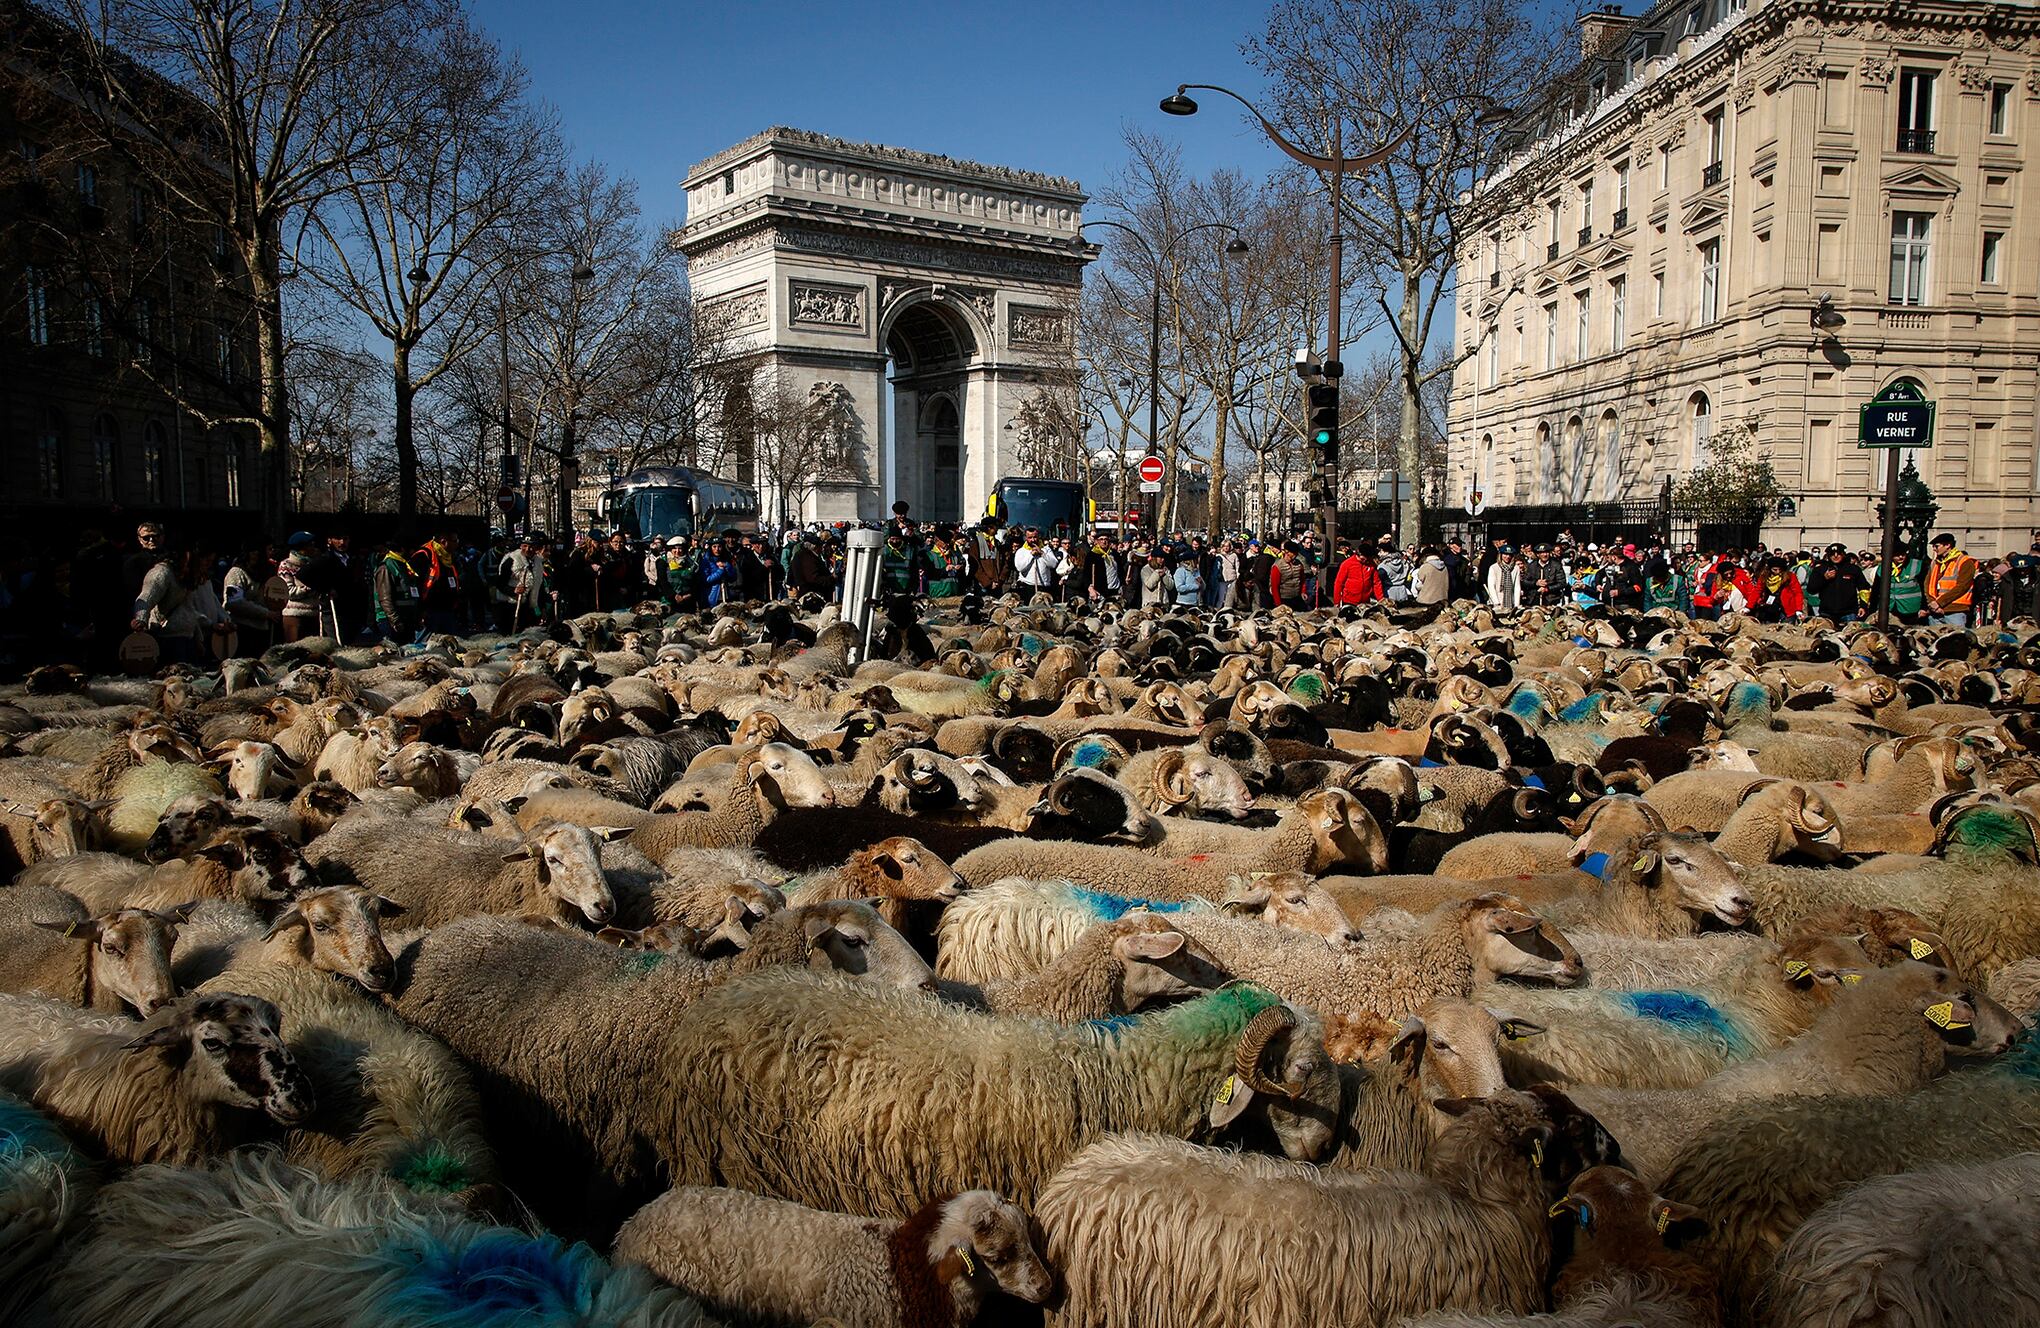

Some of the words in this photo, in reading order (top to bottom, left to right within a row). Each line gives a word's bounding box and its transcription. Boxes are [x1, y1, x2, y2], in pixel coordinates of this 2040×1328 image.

[1887, 412, 1908, 422] RUE
[1876, 427, 1916, 437] VERNET
[1925, 1008, 1948, 1025] 50036
